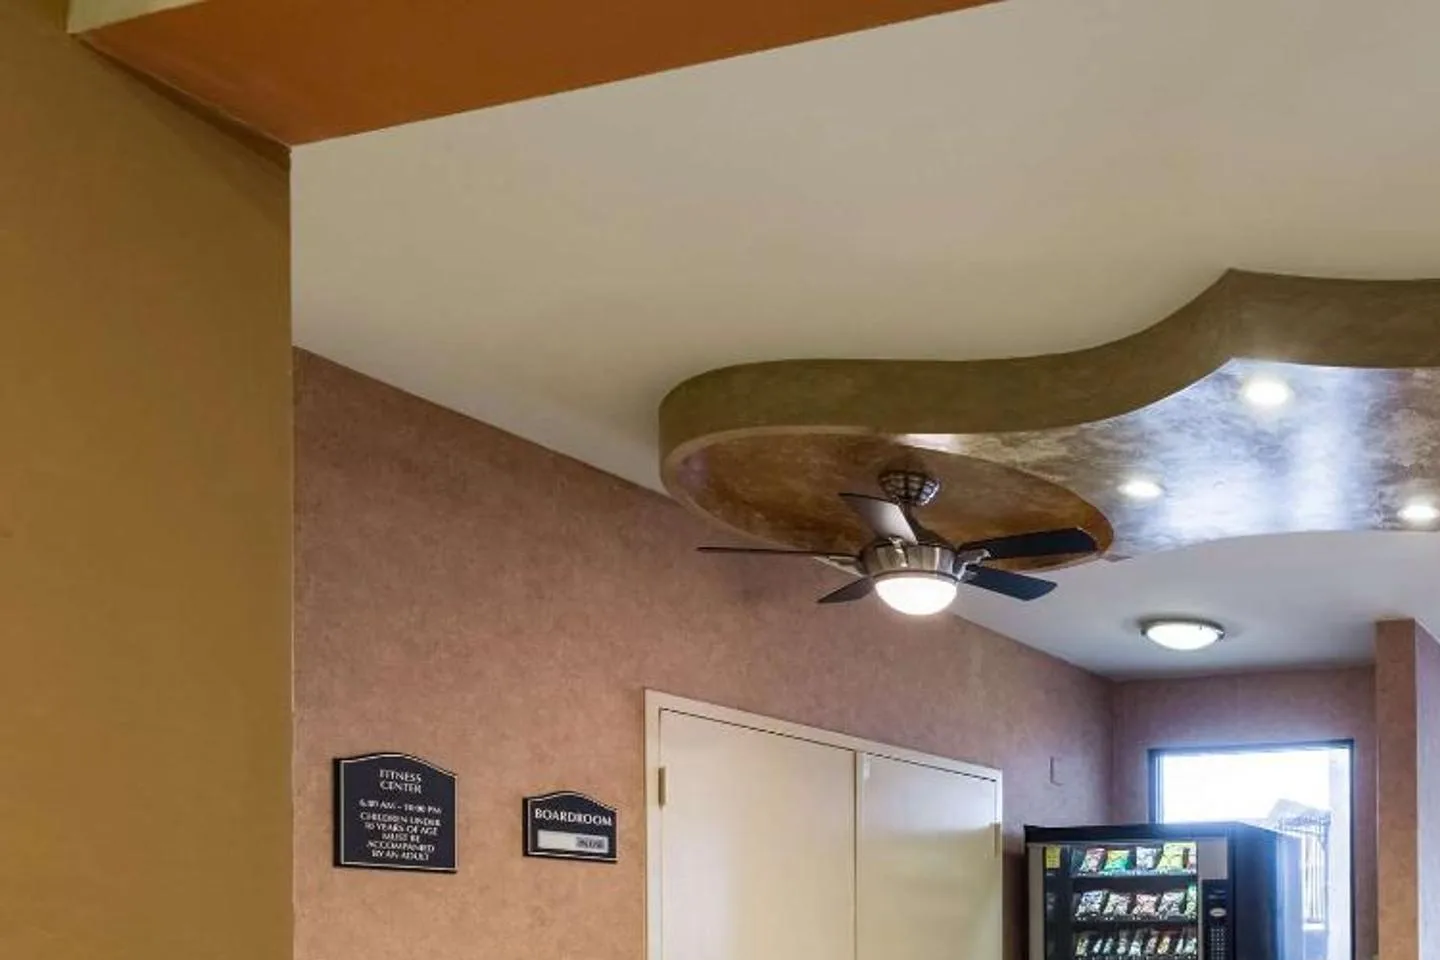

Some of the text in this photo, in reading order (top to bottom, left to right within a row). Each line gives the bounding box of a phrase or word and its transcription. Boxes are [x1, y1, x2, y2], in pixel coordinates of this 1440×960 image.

[379, 768, 422, 782] FITNESS
[379, 780, 422, 794] CENTER
[360, 811, 441, 827] CHILDREN UNDER
[534, 807, 613, 826] BOARDROOM
[376, 823, 404, 833] YEARS
[406, 825, 418, 834] OF
[420, 826, 438, 836] AGE
[381, 832, 408, 841] MUST
[366, 840, 435, 852] ACCOMPANIED
[401, 852, 430, 861] ADULT
